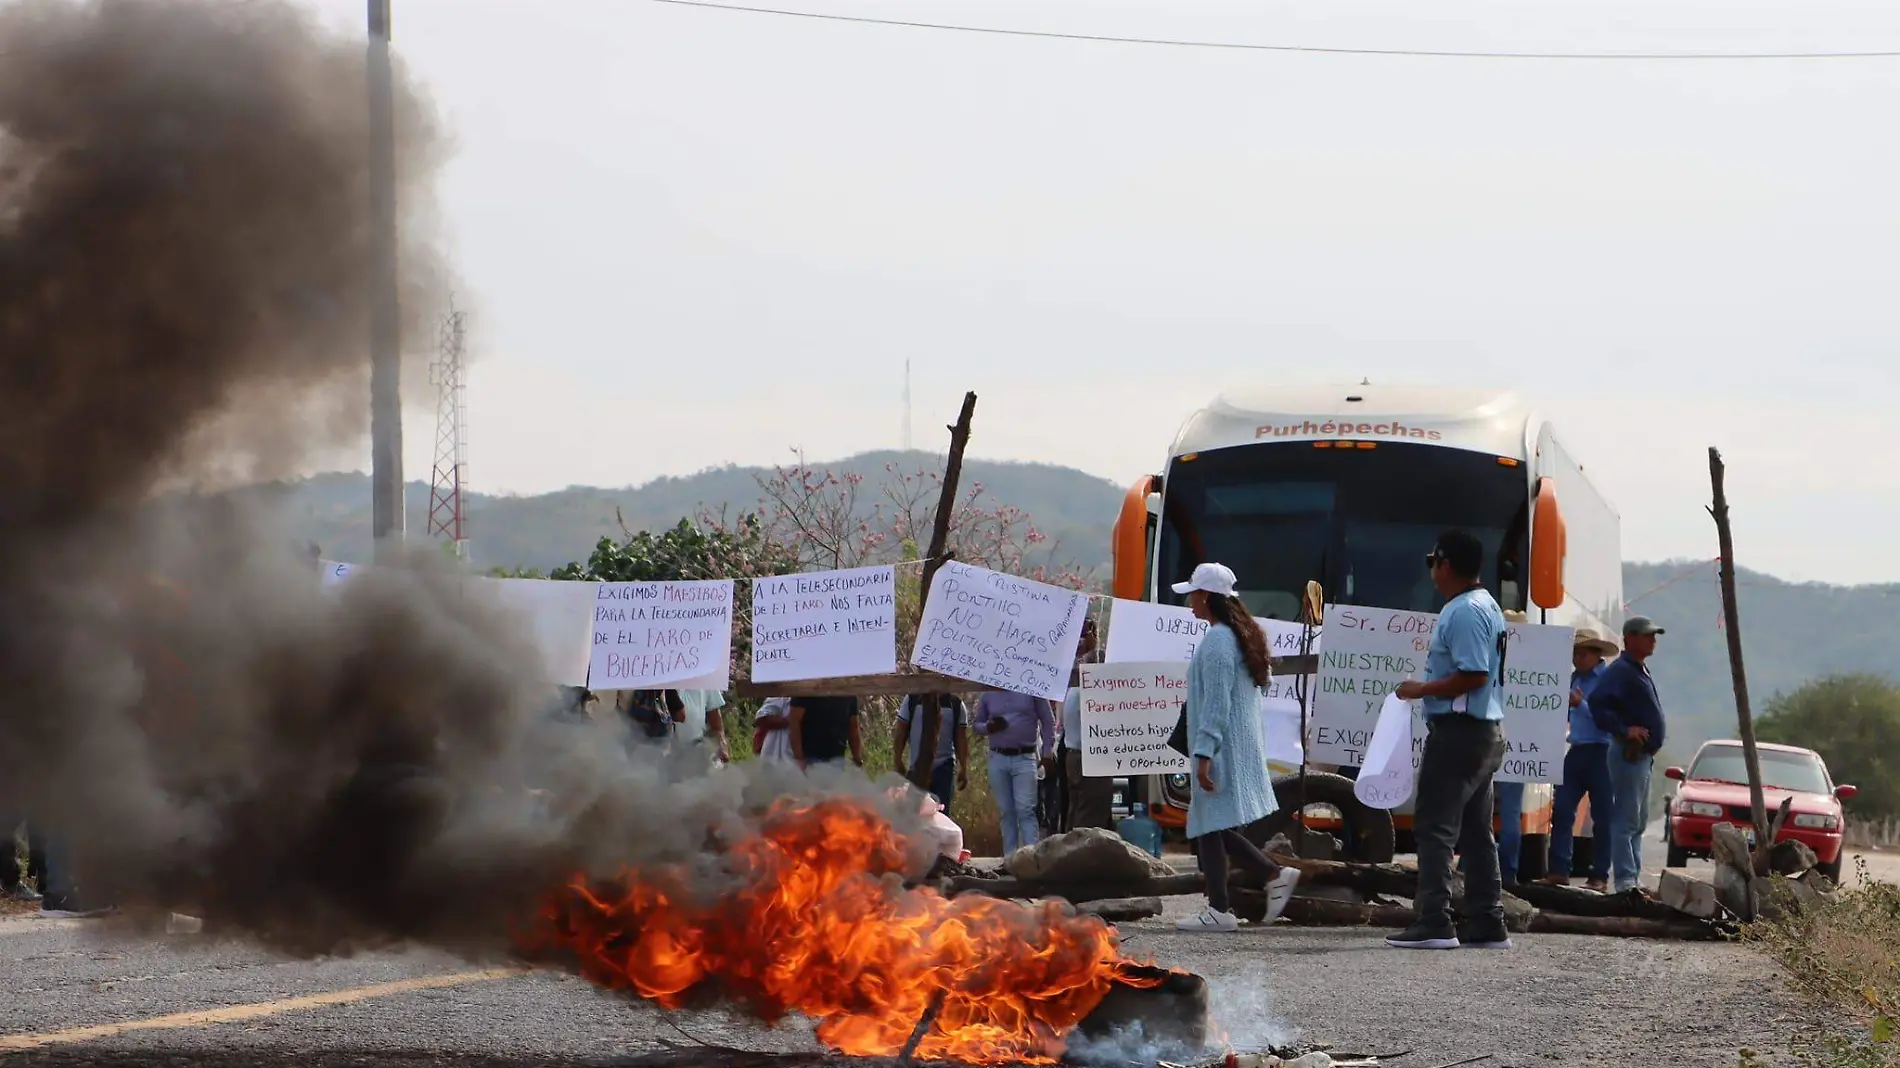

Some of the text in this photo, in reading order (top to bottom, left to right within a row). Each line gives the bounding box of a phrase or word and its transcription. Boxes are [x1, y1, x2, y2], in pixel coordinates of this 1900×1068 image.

[1255, 420, 1442, 440] Purhépechas
[950, 563, 973, 578] LIC
[597, 584, 727, 602] EXIGIMOS MAESTROS
[753, 572, 891, 600] A LA TELESECUNDARIA
[595, 605, 727, 623] PARA LA TELESECUNDARIA
[754, 604, 766, 616] DE
[794, 599, 824, 612] FARO
[830, 594, 850, 611] NOS
[857, 594, 893, 612] FALTA
[947, 606, 1047, 653] NO HAGAS
[1340, 611, 1375, 631] Sr.
[594, 628, 713, 648] DE EL FARO DE
[755, 622, 828, 646] SECRETARIA
[834, 621, 841, 632] E
[607, 646, 700, 678] BUCERÍAS
[755, 648, 791, 662] DENTE
[1322, 650, 1416, 673] NUESTROS
[993, 662, 1013, 677] DE
[1081, 672, 1146, 691] Exigimos
[1323, 676, 1355, 694] UNA
[1086, 699, 1114, 713] Para
[1119, 696, 1167, 711] nuestra
[1089, 723, 1174, 738] Nuestros hijos
[1089, 746, 1108, 755] una
[1520, 741, 1540, 752] LA
[1504, 759, 1549, 777] COIRE
